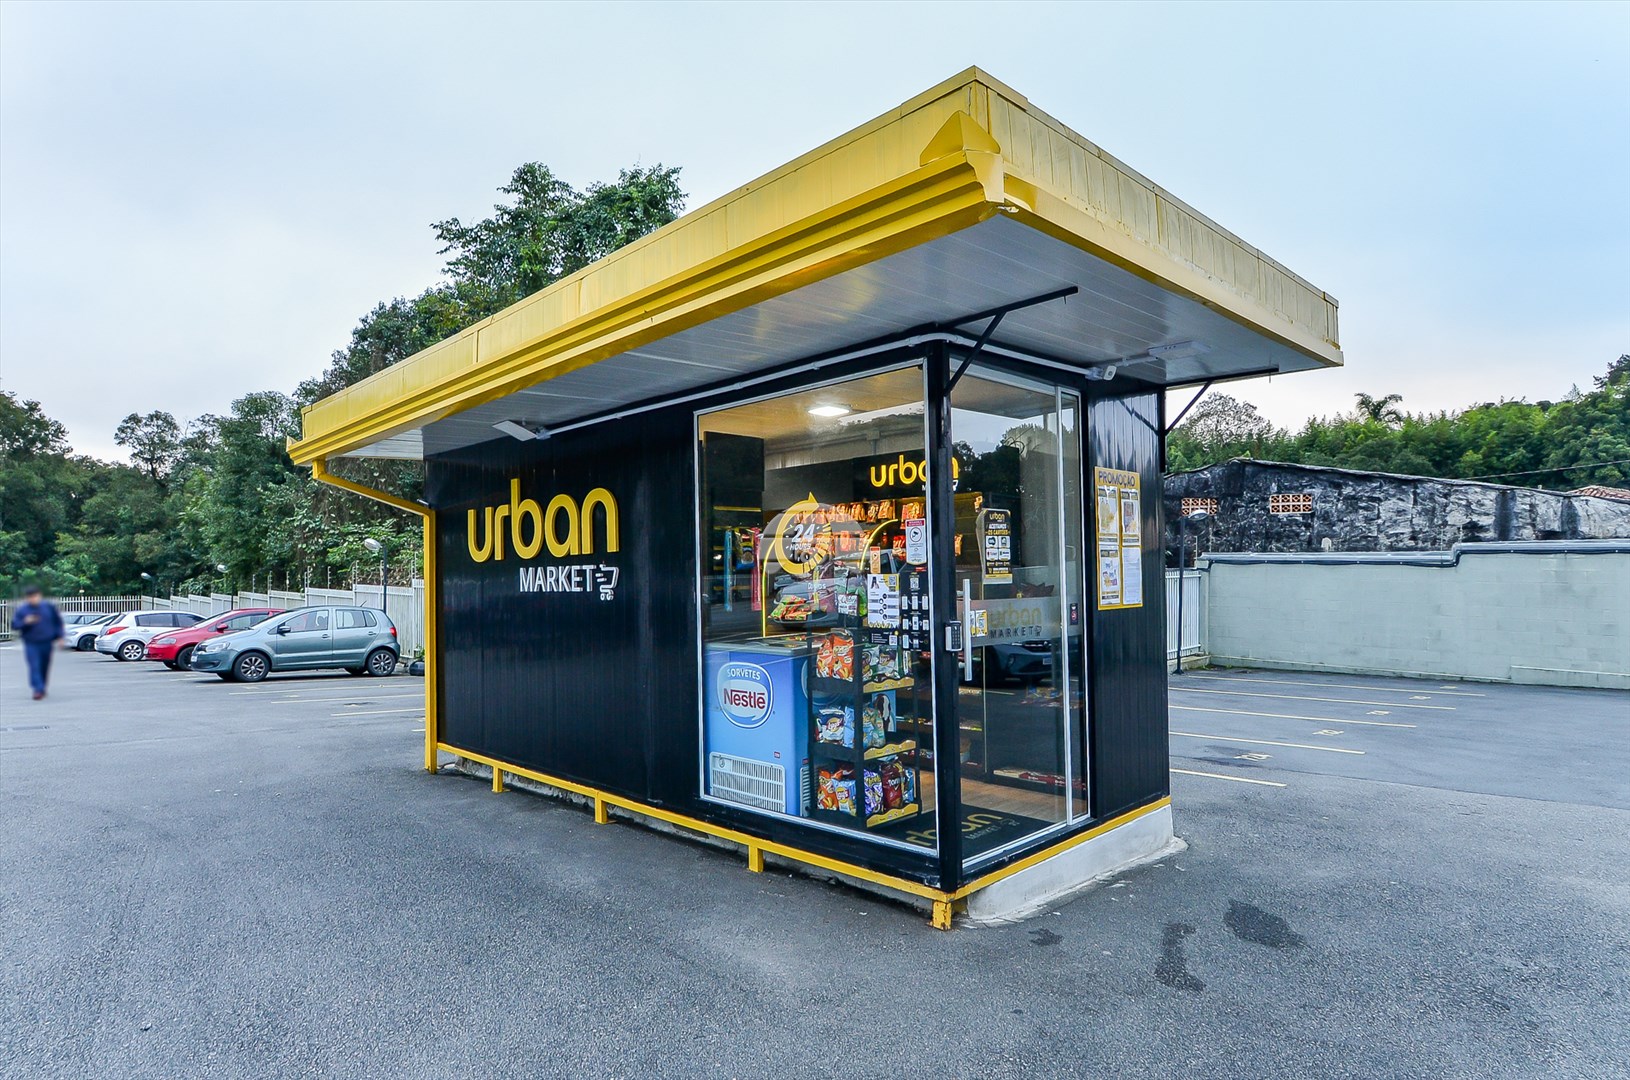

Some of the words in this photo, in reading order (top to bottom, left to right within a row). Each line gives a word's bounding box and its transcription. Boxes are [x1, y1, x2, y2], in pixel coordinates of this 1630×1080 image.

[467, 477, 620, 563] urban
[791, 523, 816, 543] 24
[519, 564, 597, 592] MARKET
[989, 626, 1034, 639] MARKET
[726, 667, 761, 681] SORVETES
